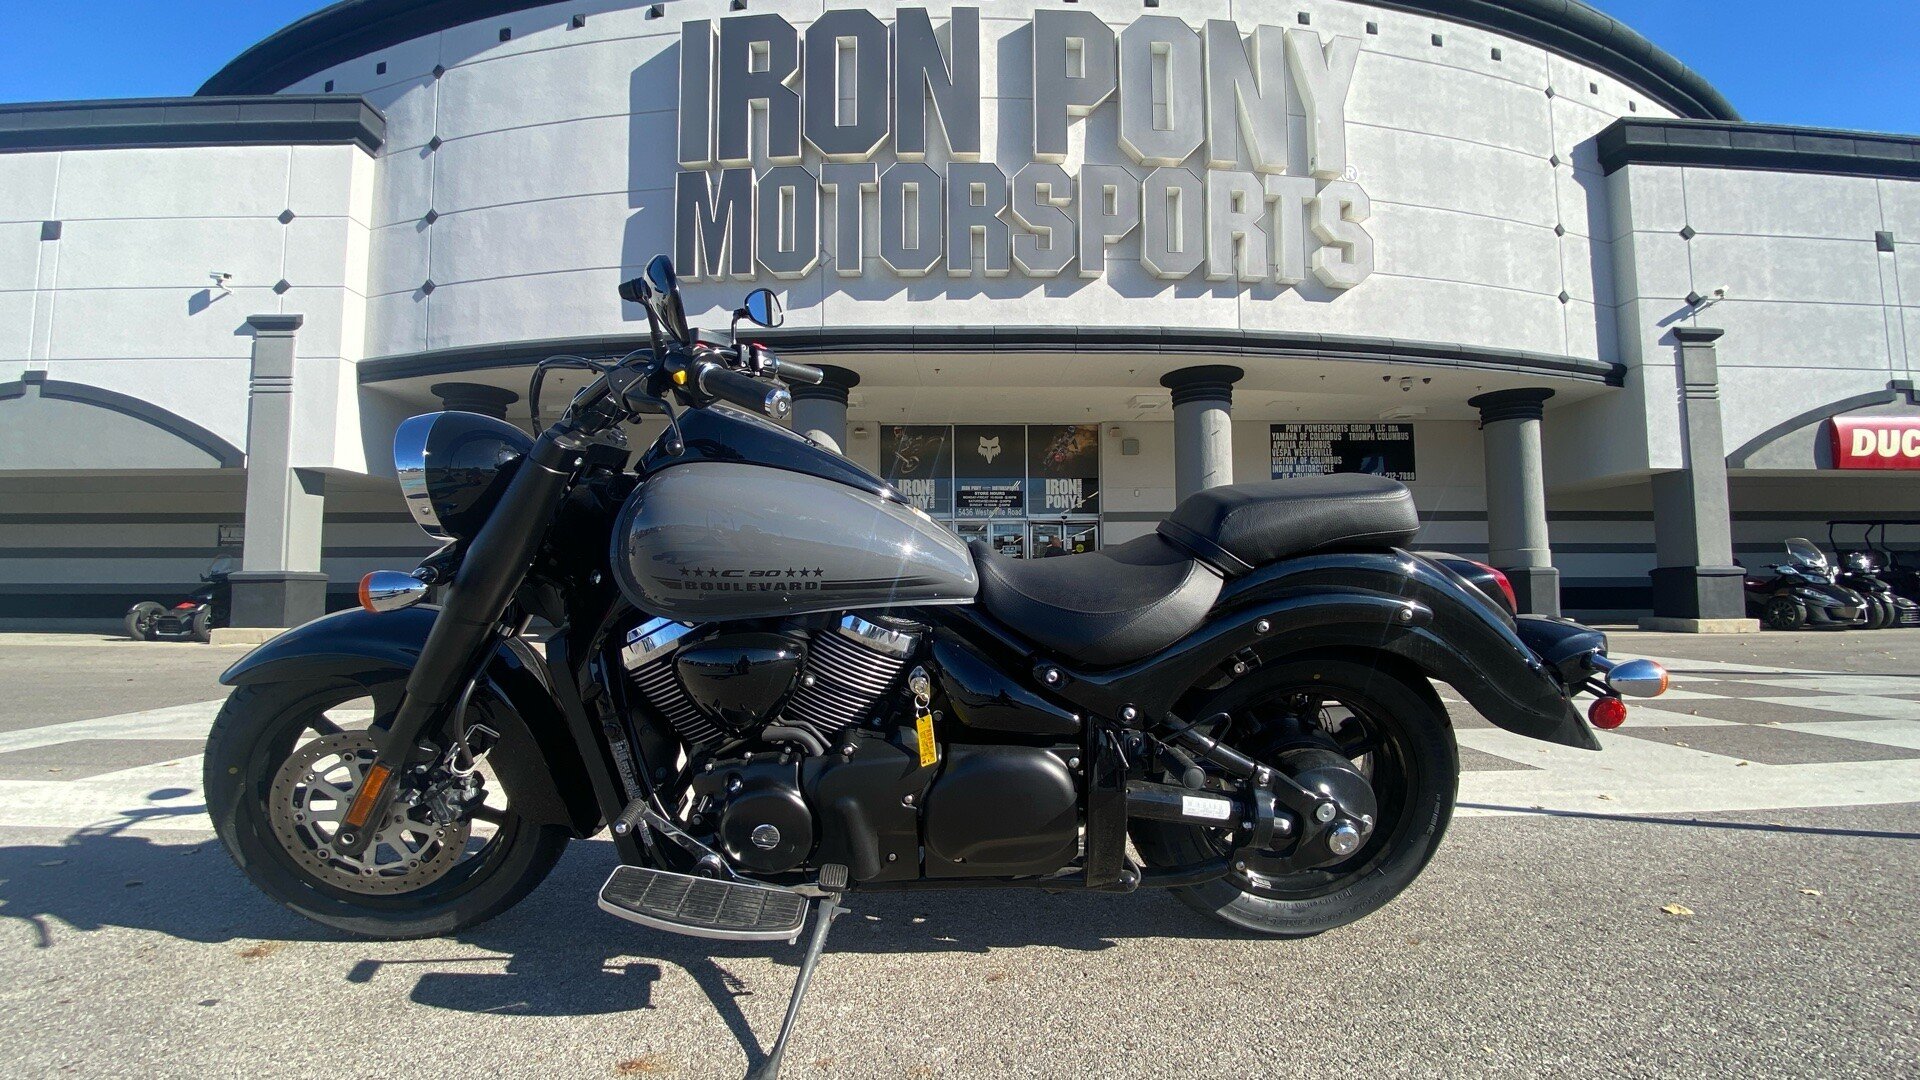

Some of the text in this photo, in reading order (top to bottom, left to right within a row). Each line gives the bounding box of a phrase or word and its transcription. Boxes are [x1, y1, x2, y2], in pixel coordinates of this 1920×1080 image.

[677, 7, 1364, 179] IRON PONY
[675, 161, 1375, 289] MOTORSPORTS
[1285, 424, 1302, 432] PONY
[1304, 424, 1348, 432] POWERSPORTS
[1375, 424, 1386, 432] LLC
[1271, 432, 1342, 440] YAMAHA OF COLUMBUS
[1349, 432, 1409, 441] TRIUMPH COLUMBUS
[1272, 441, 1297, 449] APRILIA
[1851, 428, 1920, 458] DUC
[1271, 448, 1333, 457] VESPA WESTERVILLE
[1272, 456, 1343, 464] VICTORY OF COLUMBUS
[1272, 464, 1335, 473] INDIAN MOTORCYCLE
[898, 479, 930, 496] IRON
[1046, 478, 1077, 495] IRON
[1046, 494, 1077, 509] PONY
[1007, 507, 1022, 516] Road
[721, 569, 781, 578] C 90
[684, 581, 818, 592] BOULEVARD
